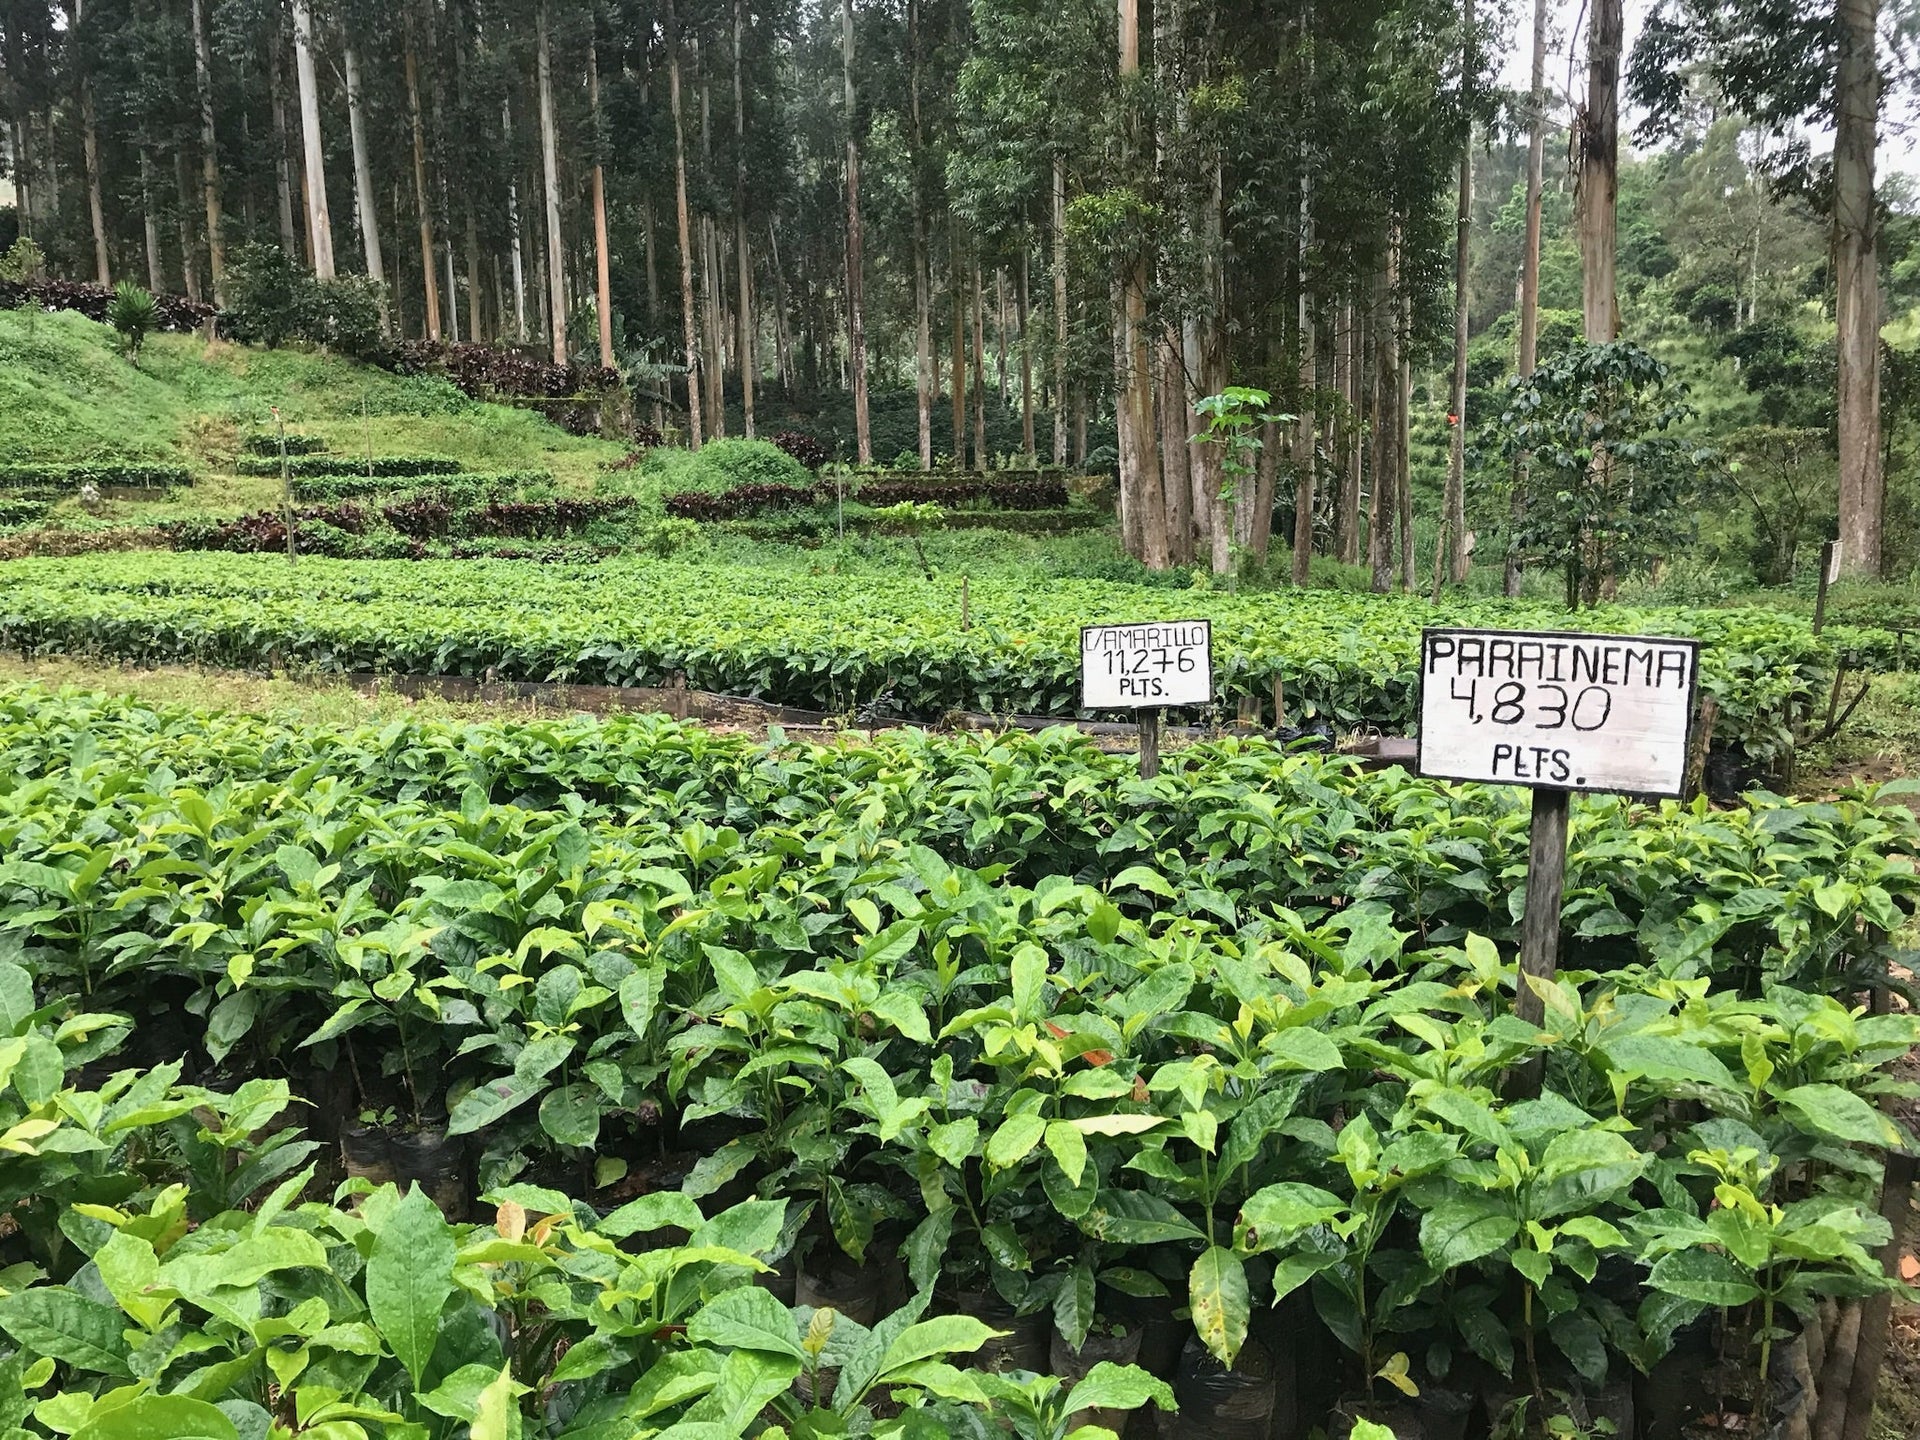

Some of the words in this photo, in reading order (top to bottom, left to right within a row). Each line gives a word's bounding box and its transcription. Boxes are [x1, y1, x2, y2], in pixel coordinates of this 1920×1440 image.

[1103, 647, 1195, 676] 11,276
[1428, 637, 1686, 689] PARAINEMA
[1119, 677, 1169, 698] PLTS.
[1450, 676, 1611, 731] 4,830
[1491, 743, 1586, 785] PLTS.
